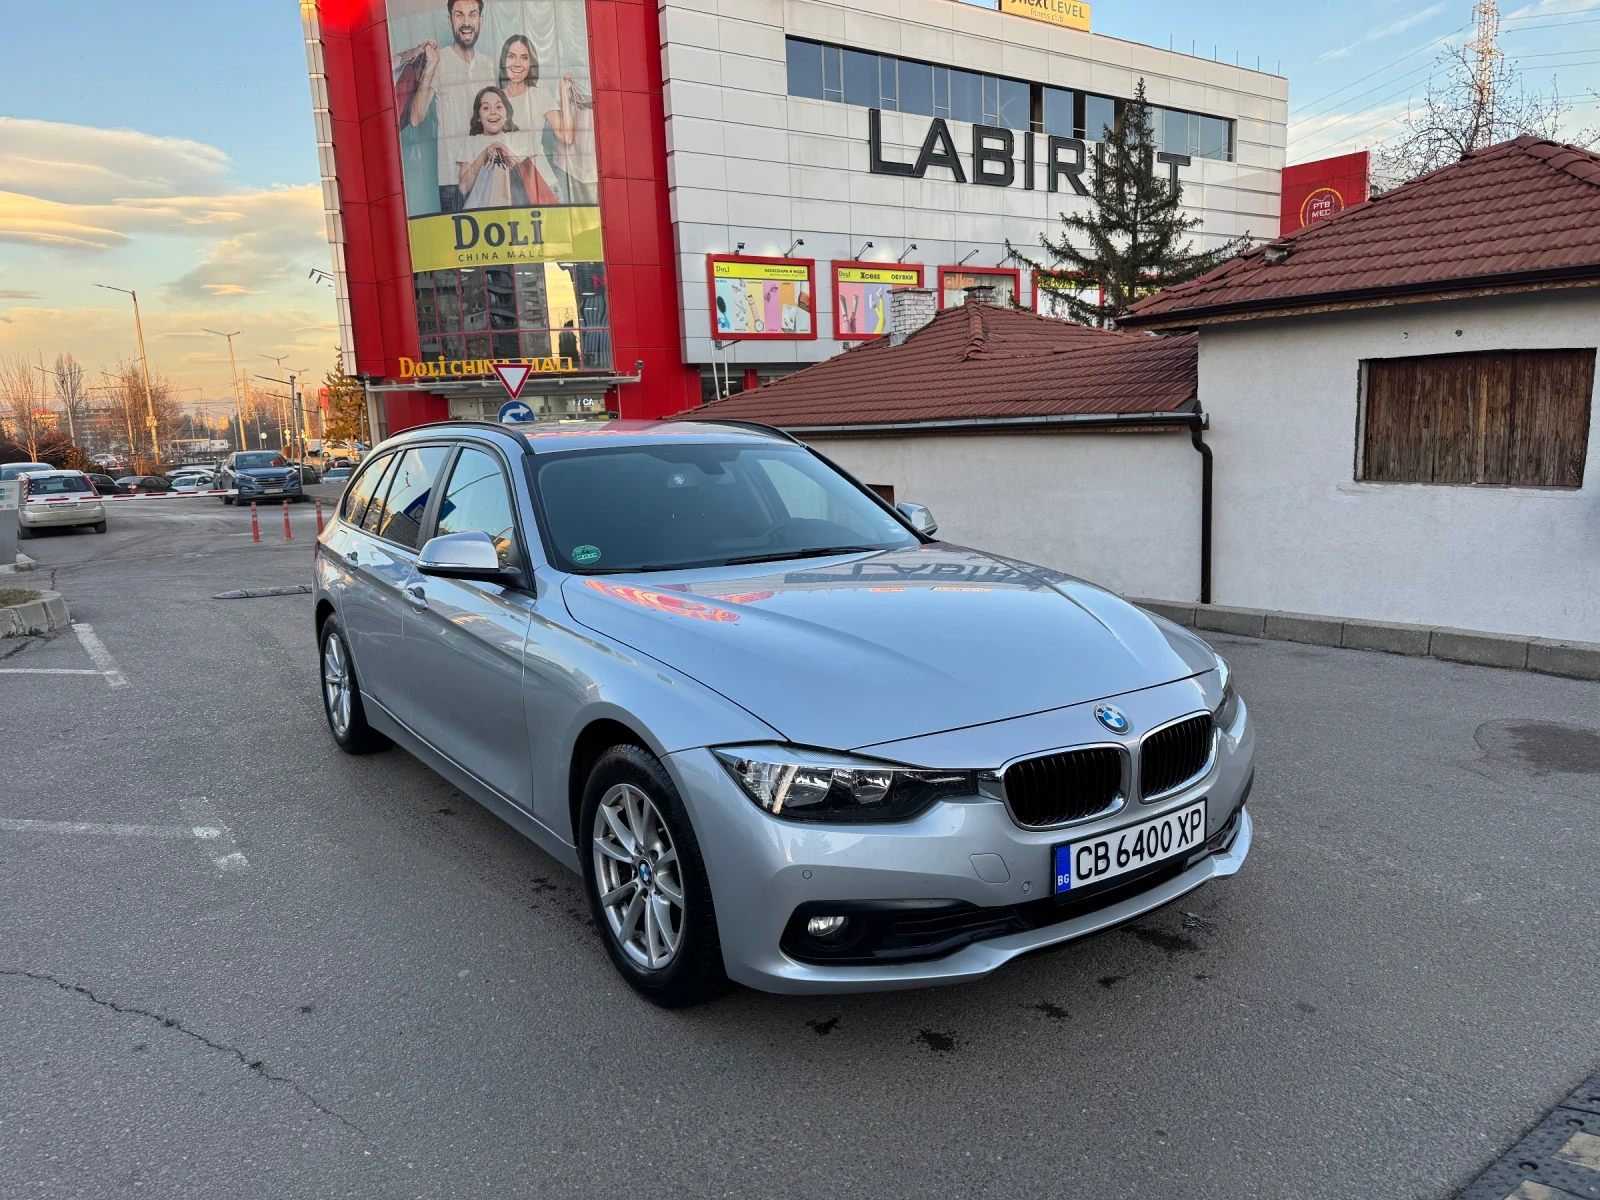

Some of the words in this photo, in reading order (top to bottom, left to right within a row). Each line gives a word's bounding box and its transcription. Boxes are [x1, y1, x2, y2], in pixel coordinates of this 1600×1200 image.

[1030, 8, 1050, 20] fitness
[1051, 13, 1064, 23] club
[1051, 0, 1085, 19] LEVEL
[458, 252, 499, 262] CHINA
[507, 250, 544, 259] MALL
[1076, 841, 1110, 880] CB
[1116, 821, 1172, 868] 6400
[1177, 808, 1202, 848] XP
[1057, 873, 1070, 886] BG
